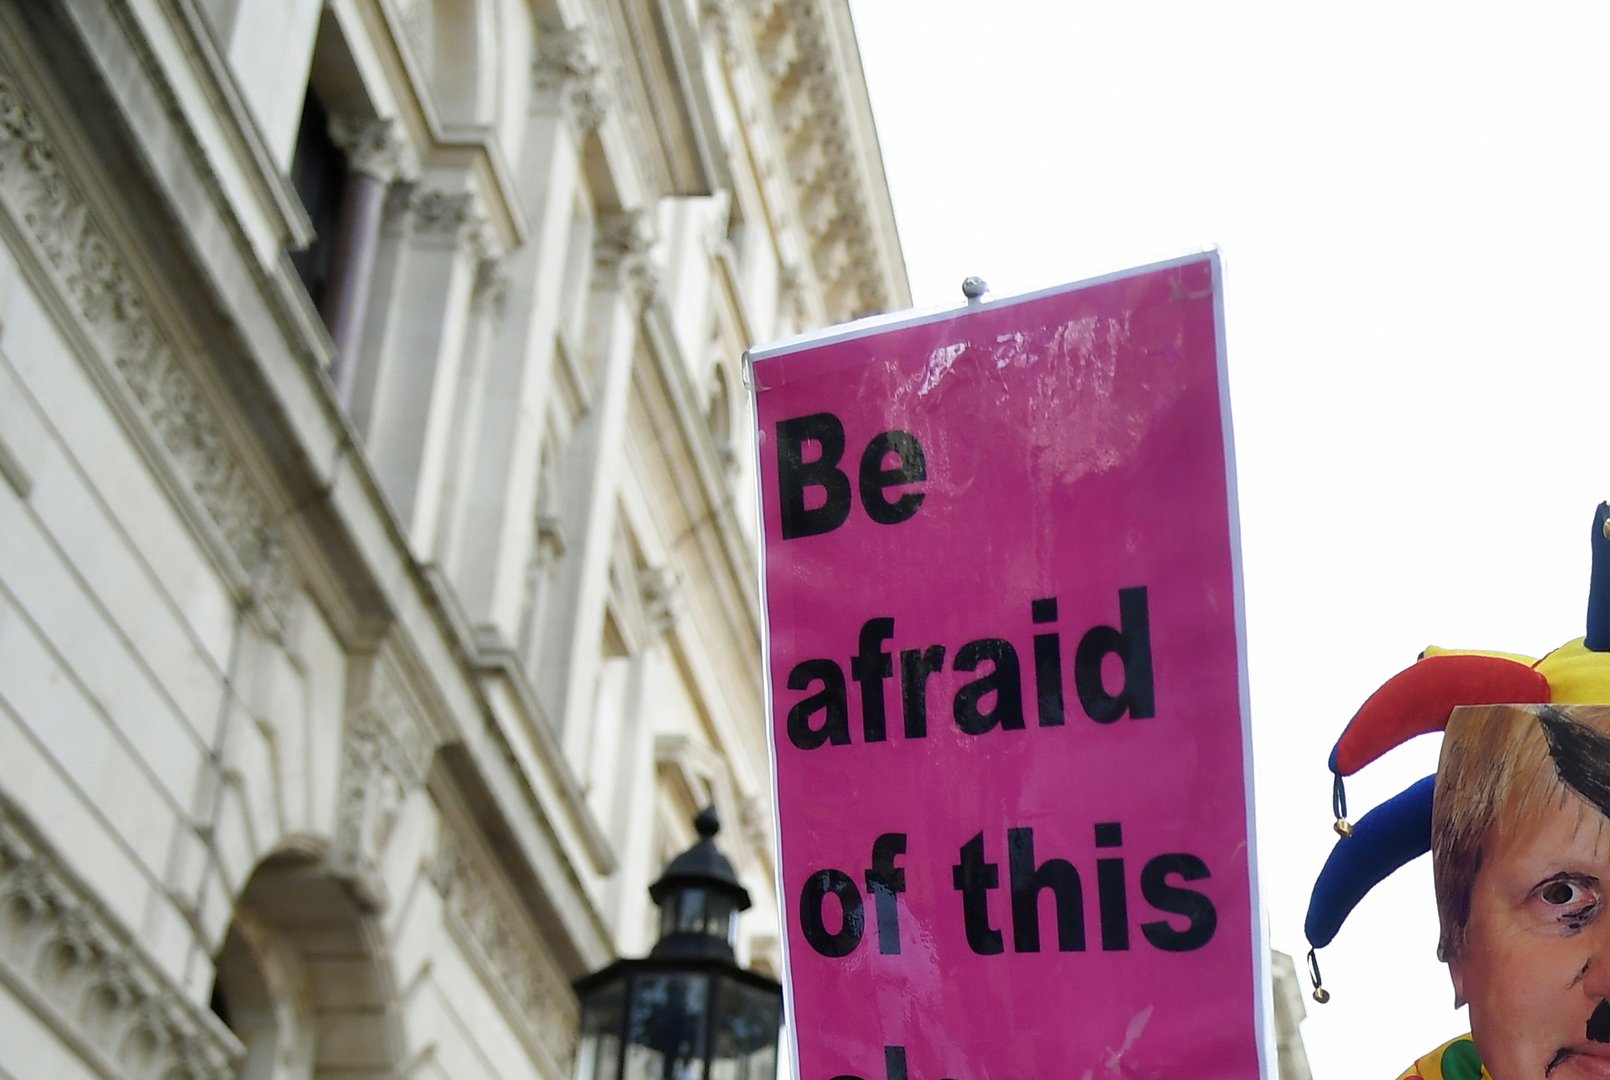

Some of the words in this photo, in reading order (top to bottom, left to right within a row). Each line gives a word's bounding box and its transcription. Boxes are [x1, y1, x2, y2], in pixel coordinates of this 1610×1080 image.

[776, 412, 927, 540] Be
[787, 586, 1155, 750] afraid
[800, 833, 907, 958] of
[952, 822, 1218, 955] this
